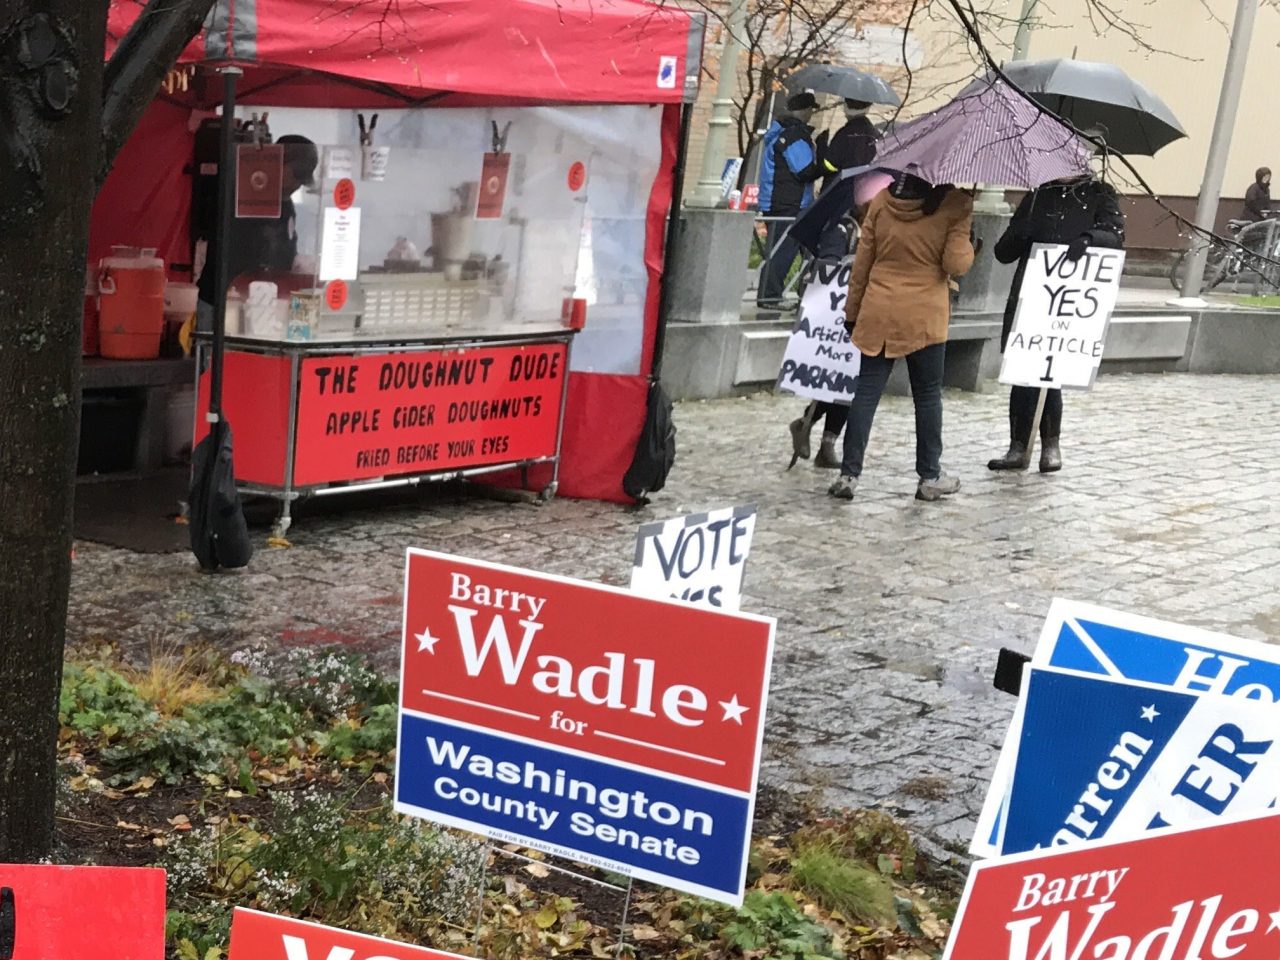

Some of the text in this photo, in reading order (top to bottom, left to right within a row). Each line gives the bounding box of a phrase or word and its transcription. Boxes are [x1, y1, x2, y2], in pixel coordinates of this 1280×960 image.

[819, 263, 851, 288] VO
[1043, 250, 1119, 284] VOTE
[1043, 284, 1098, 318] YES
[795, 317, 851, 344] Article
[1051, 320, 1070, 331] ON
[815, 345, 853, 363] More
[1011, 332, 1102, 358] ARTICLE
[315, 352, 561, 395] THE DOUGHNUT DUDE
[783, 359, 858, 394] PARKIN
[1039, 355, 1054, 382] 1
[326, 409, 381, 436] APPLE
[448, 396, 542, 424] DOUGHNUTS
[397, 443, 440, 464] BEFORE
[448, 439, 475, 458] YOUR
[481, 435, 510, 455] EYES
[653, 513, 752, 581] VOTE
[449, 572, 546, 621] Barry
[448, 605, 708, 727] Wadle
[549, 710, 588, 736] for
[426, 736, 714, 836] Washington
[1032, 730, 1154, 852] arren
[434, 776, 701, 866] County Senate
[529, 841, 552, 852] BARRY
[1013, 864, 1129, 914] Barry
